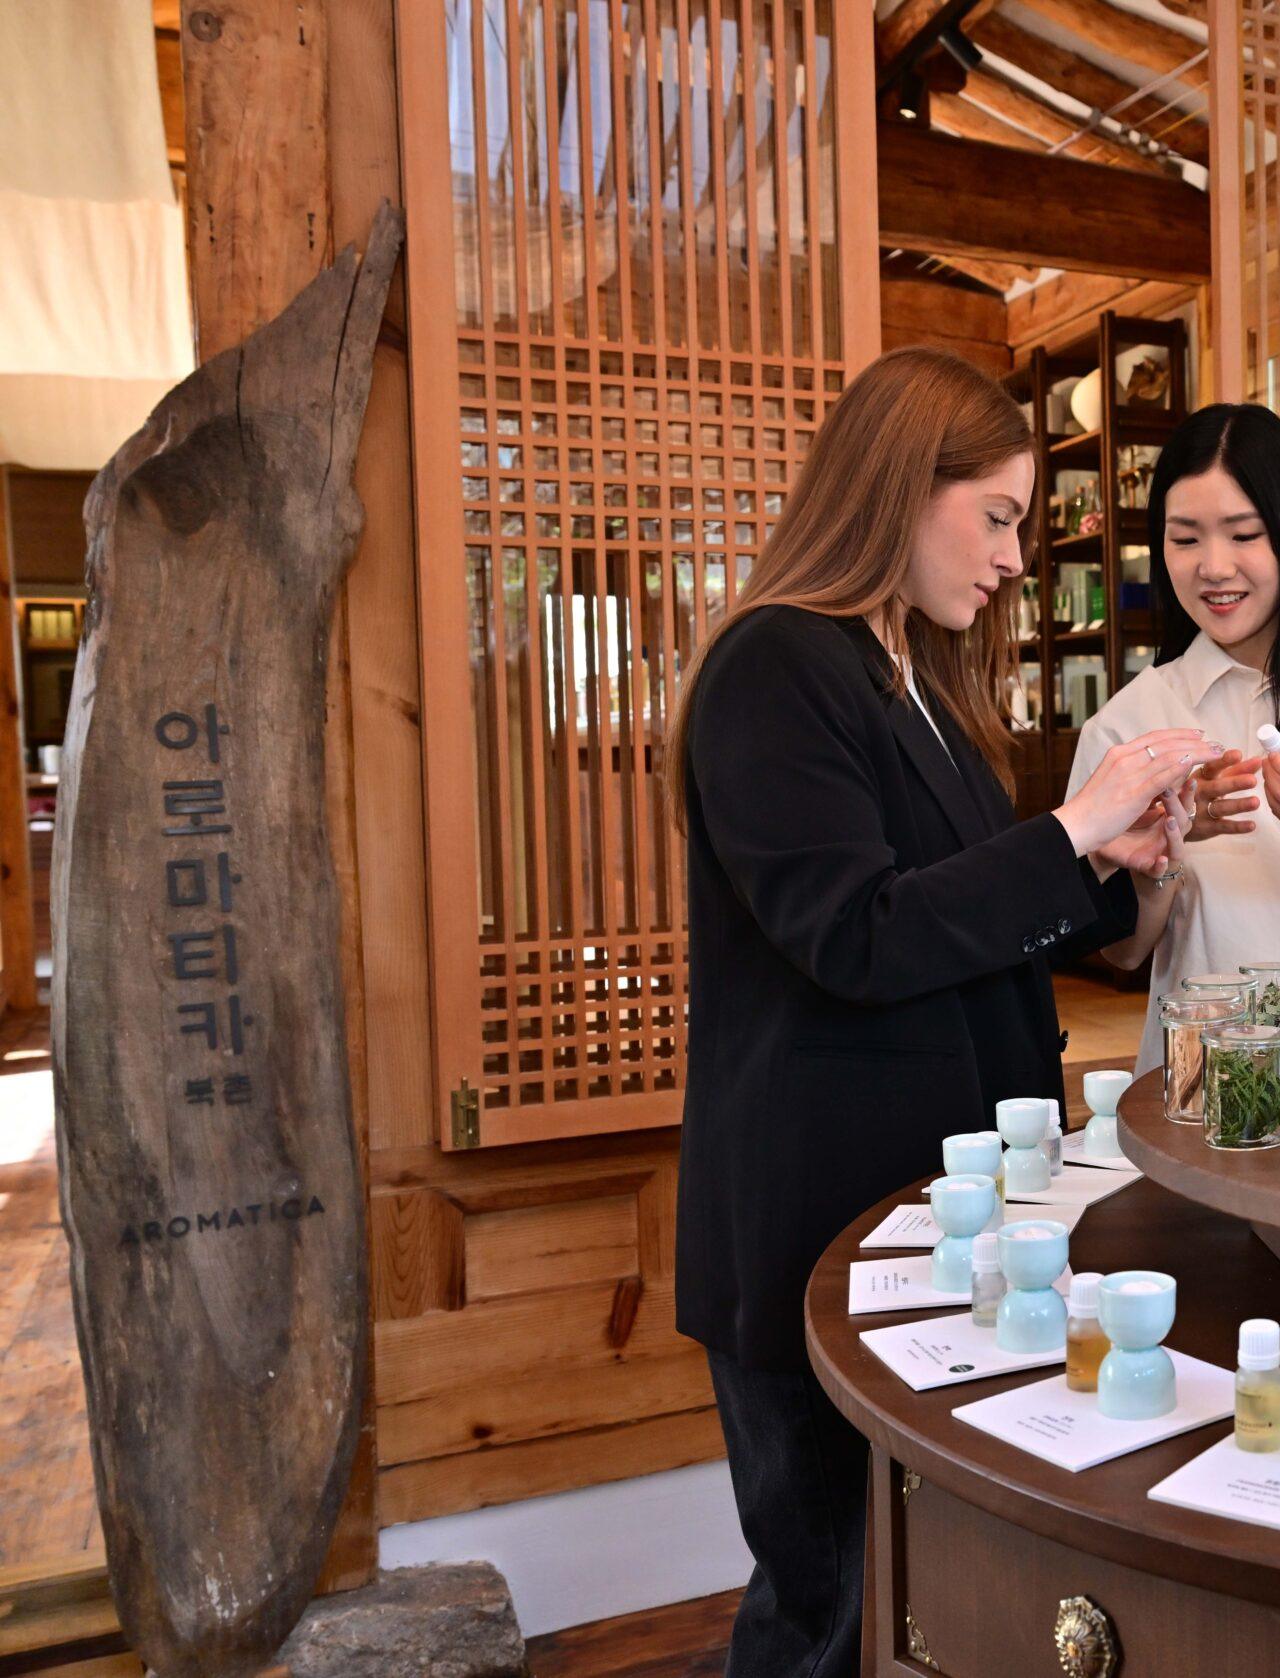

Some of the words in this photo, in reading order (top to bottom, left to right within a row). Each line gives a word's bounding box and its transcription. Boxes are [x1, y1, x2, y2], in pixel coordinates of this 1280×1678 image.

[154, 703, 254, 1055] 아로마티카
[184, 1073, 252, 1105] 북촌
[120, 1195, 325, 1246] AROMATICA
